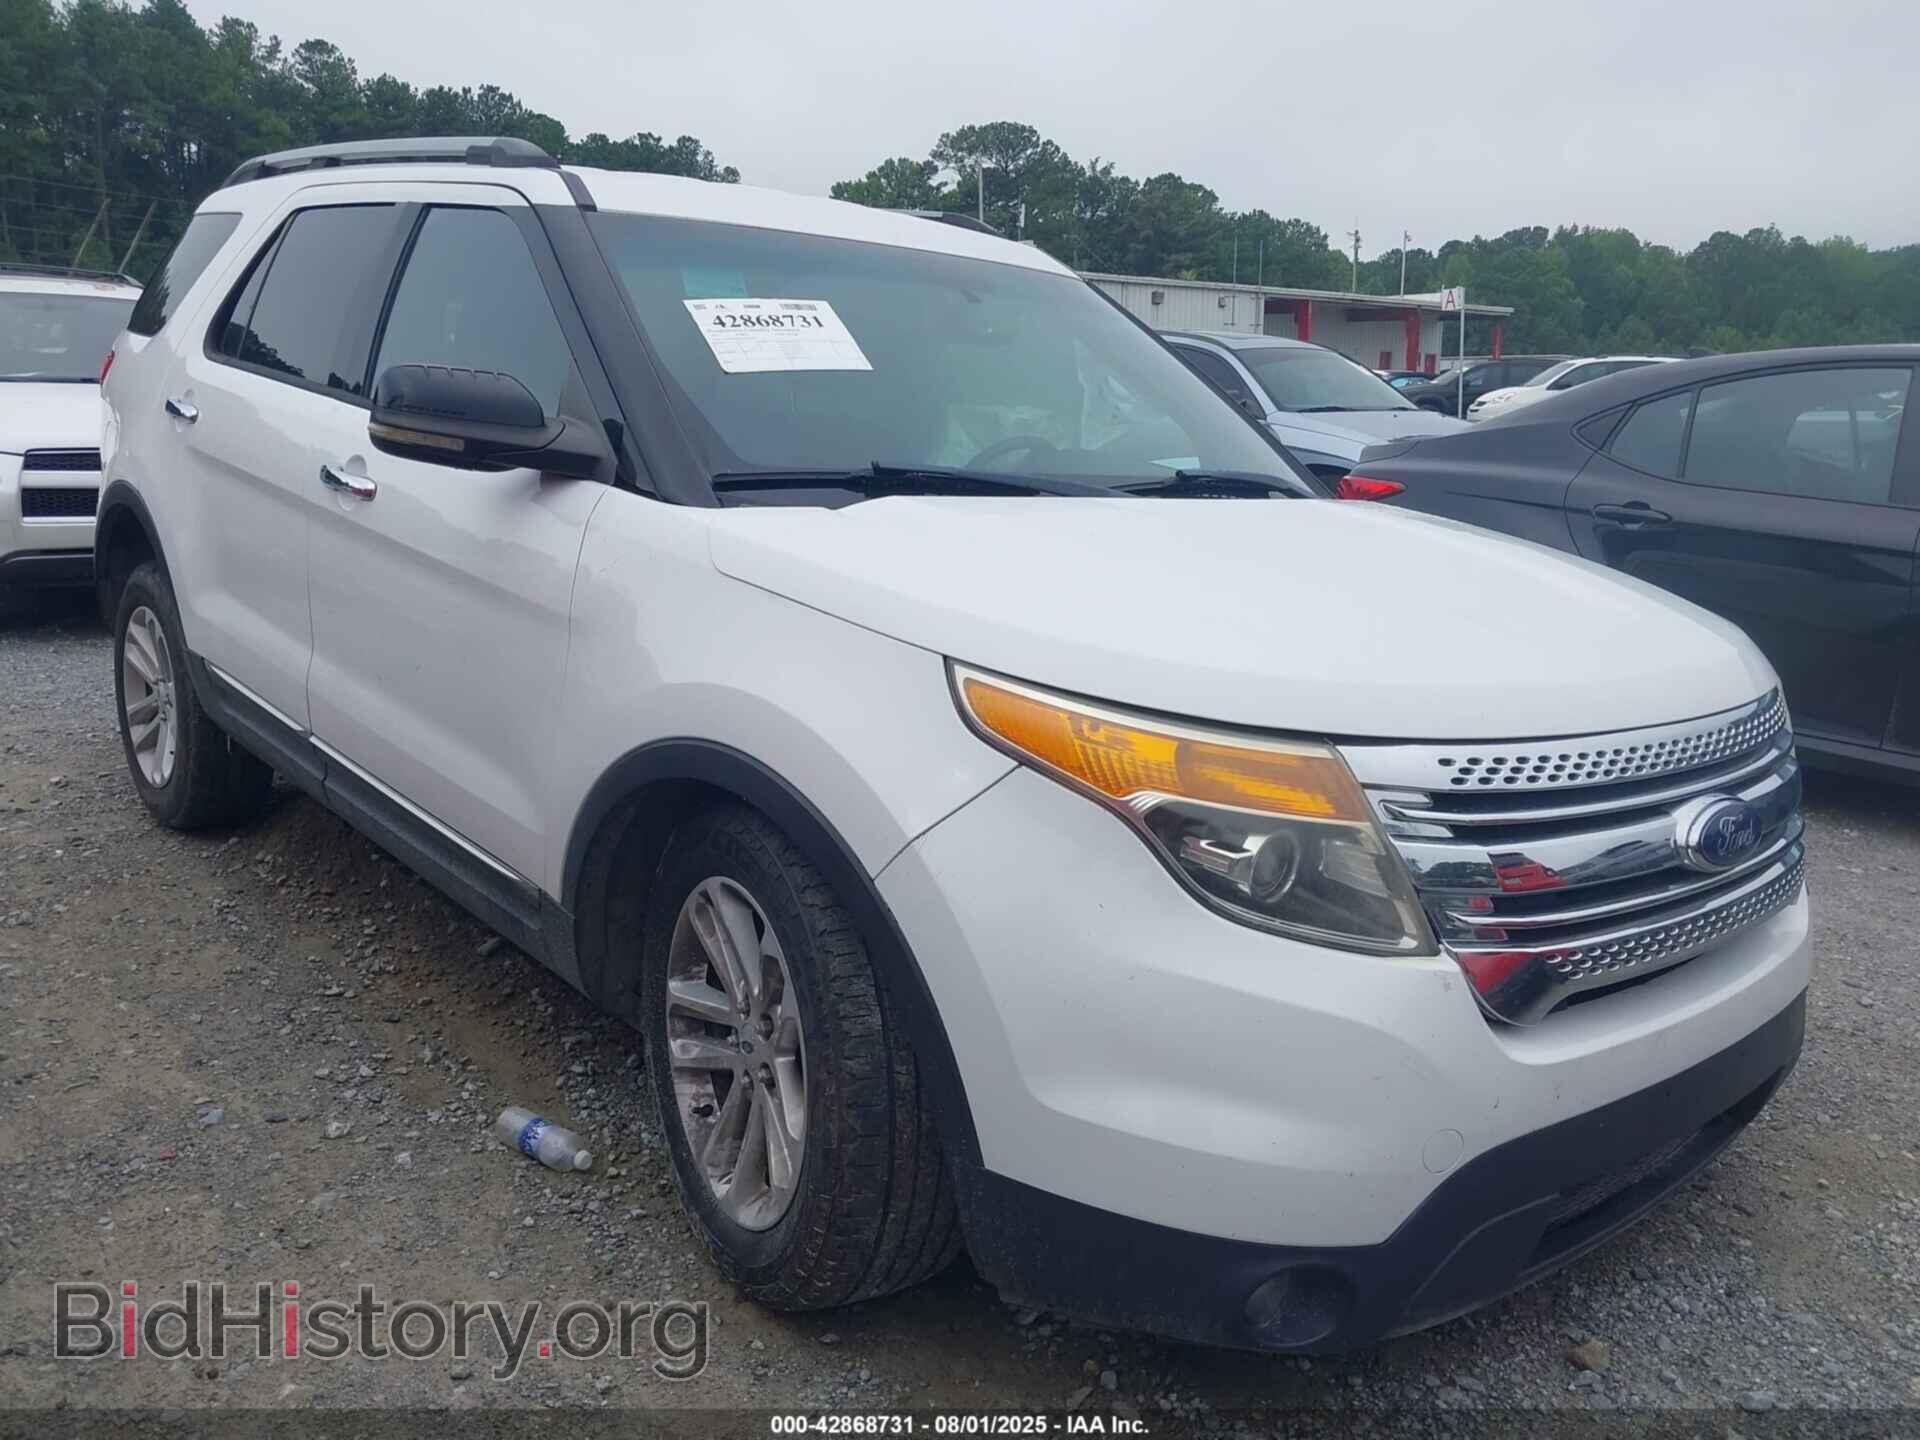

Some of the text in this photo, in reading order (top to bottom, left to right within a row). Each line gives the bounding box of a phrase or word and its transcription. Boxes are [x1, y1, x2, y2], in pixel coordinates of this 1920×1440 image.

[1445, 290, 1456, 310] A
[712, 314, 825, 328] 42868731
[1716, 814, 1758, 856] Ford
